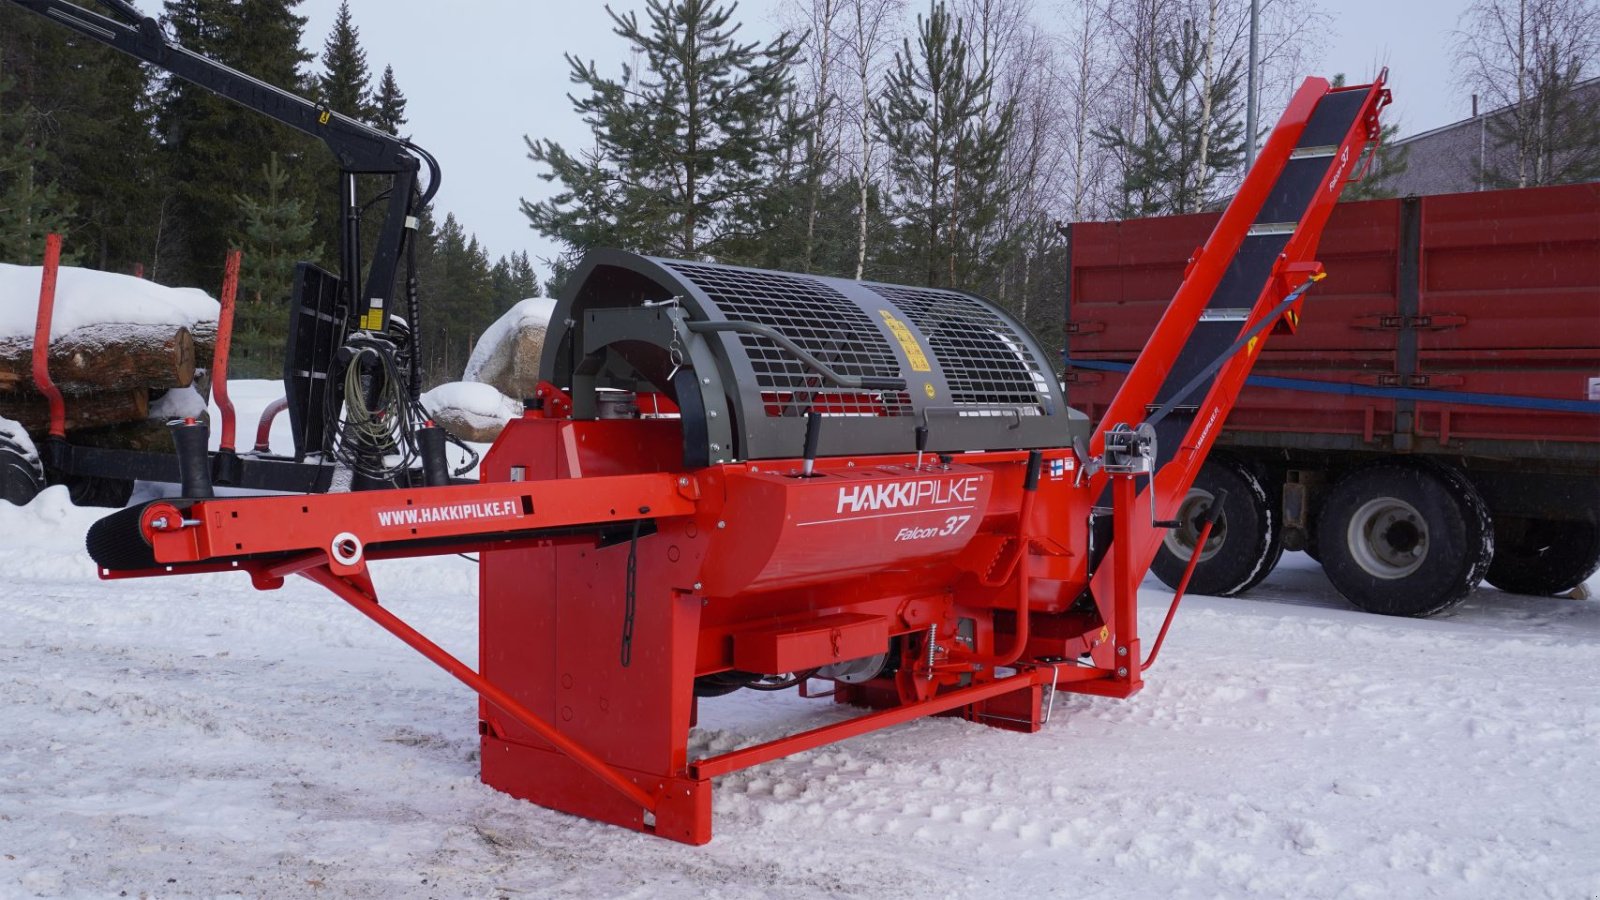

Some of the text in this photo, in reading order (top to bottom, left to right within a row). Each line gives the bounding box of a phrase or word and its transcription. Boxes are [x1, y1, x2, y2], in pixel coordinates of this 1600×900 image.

[1341, 145, 1349, 168] 37
[378, 501, 516, 527] WWW.HAKKIPILKE.FI
[894, 515, 971, 542] Falcon 37
